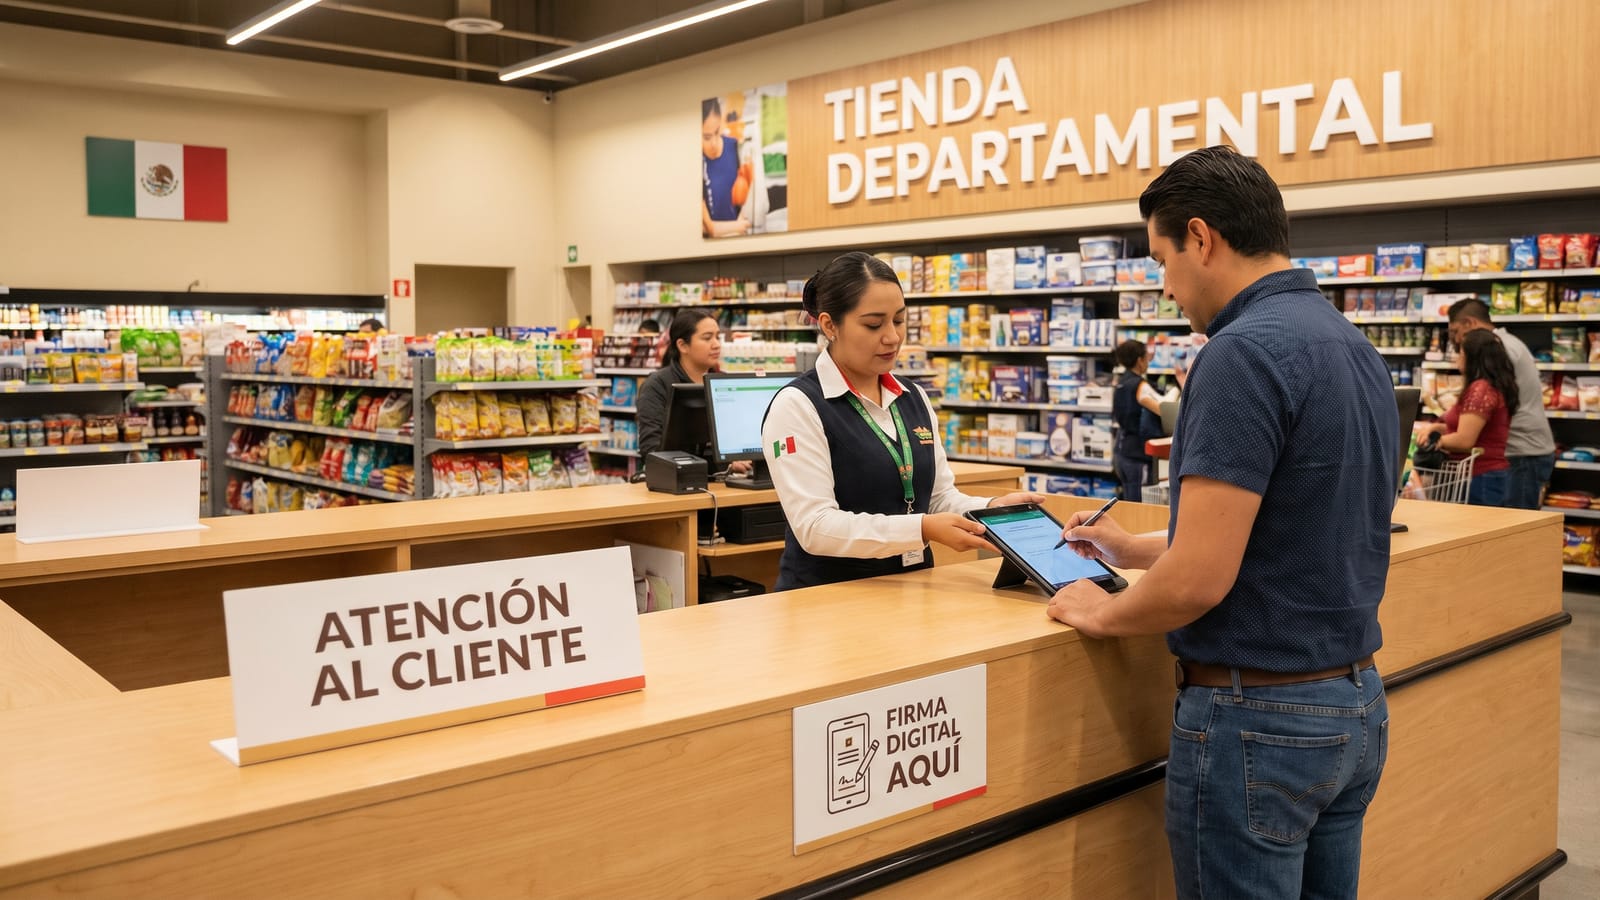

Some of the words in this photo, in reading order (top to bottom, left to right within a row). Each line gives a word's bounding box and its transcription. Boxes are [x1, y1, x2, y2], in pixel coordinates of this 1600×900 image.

[825, 57, 1029, 142] TIENDA
[828, 71, 1434, 205] DEPARTAMENTAL
[315, 578, 570, 653] ATENCIÓN
[311, 660, 379, 706] AL
[392, 626, 586, 690] CLIENTE
[886, 697, 948, 730] FIRMA
[886, 718, 961, 755] DIGITAL
[886, 737, 962, 794] AQUÍ
